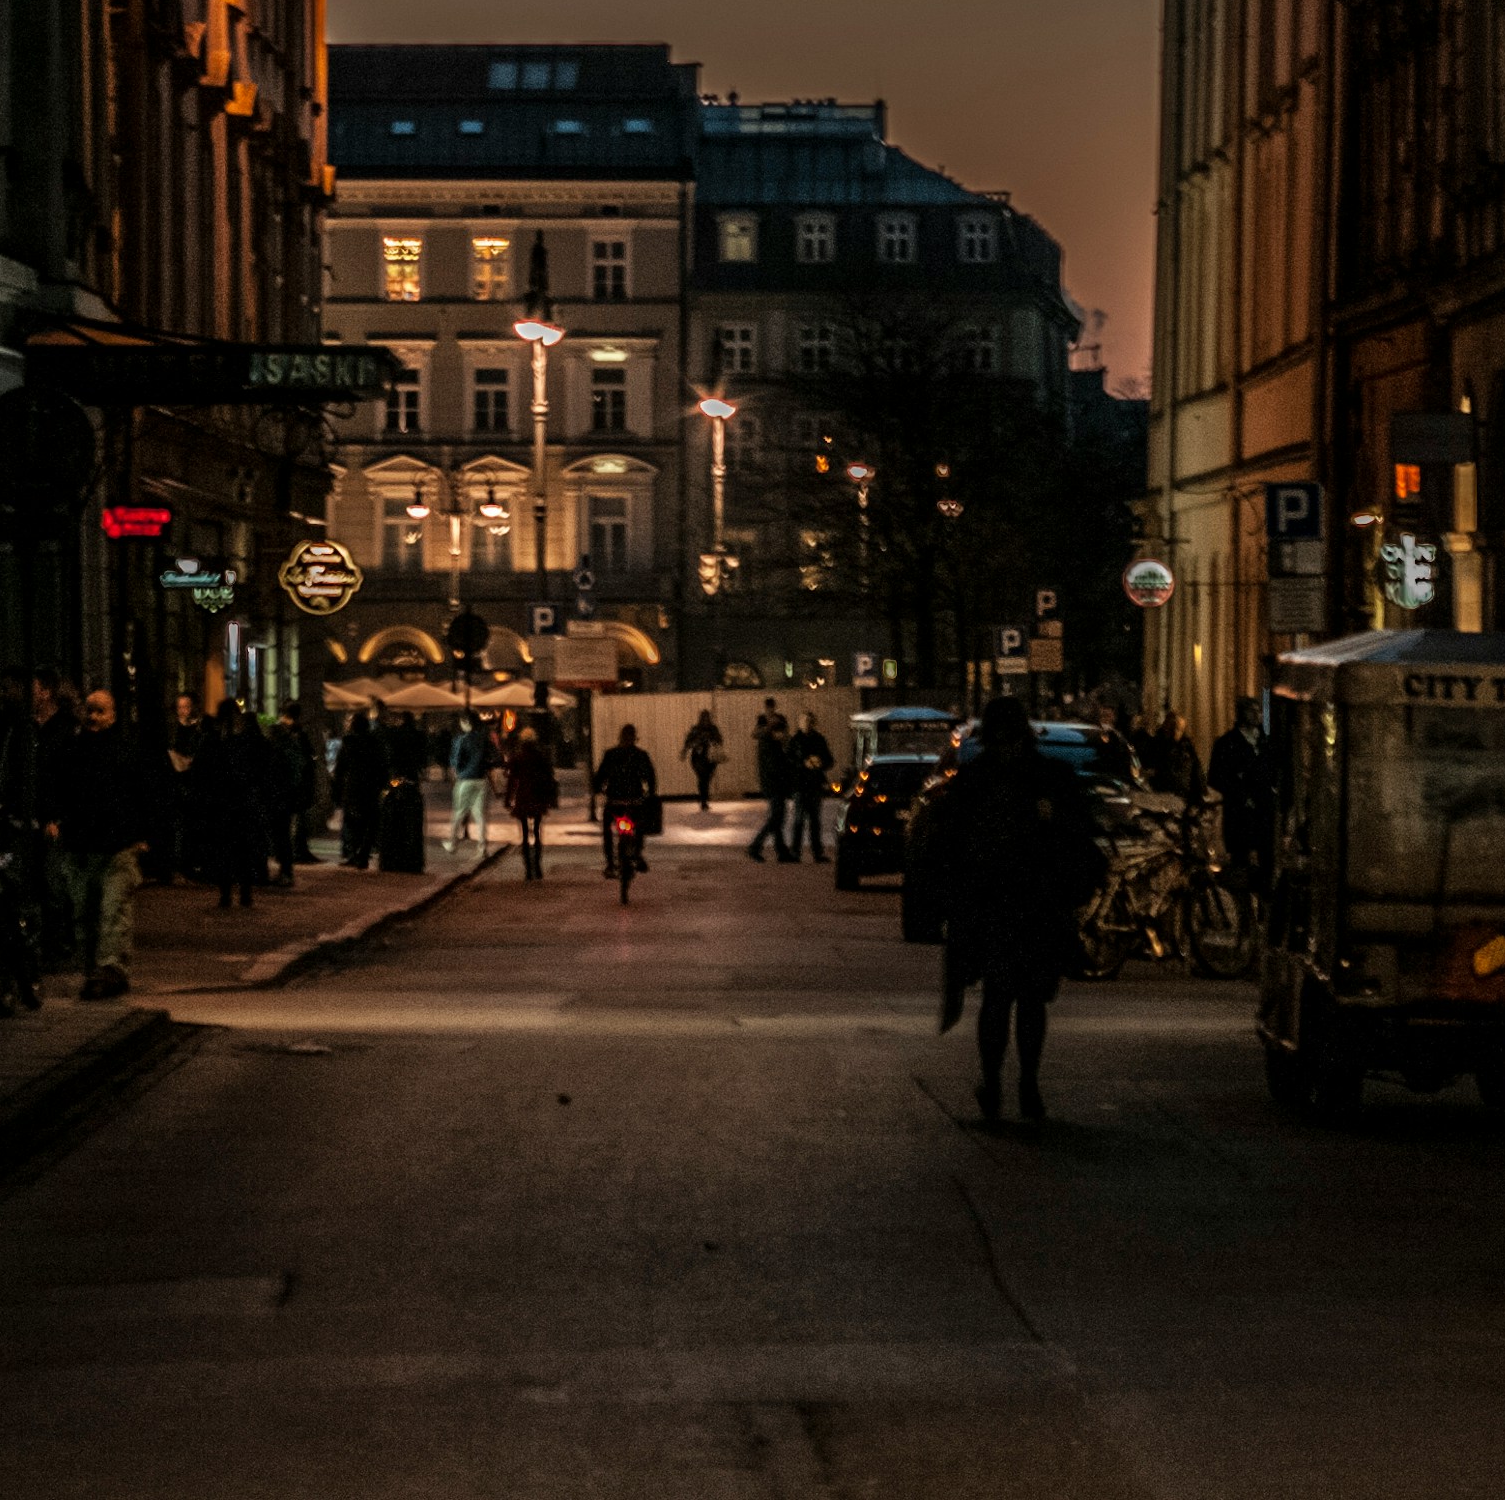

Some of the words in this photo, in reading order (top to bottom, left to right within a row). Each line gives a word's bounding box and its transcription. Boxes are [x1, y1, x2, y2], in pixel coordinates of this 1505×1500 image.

[264, 353, 367, 387] SASKI
[1277, 488, 1310, 533] P
[1036, 589, 1058, 616] P
[532, 606, 555, 635] P
[1001, 629, 1022, 656] P
[855, 654, 874, 676] P
[1403, 673, 1482, 701] CITY
